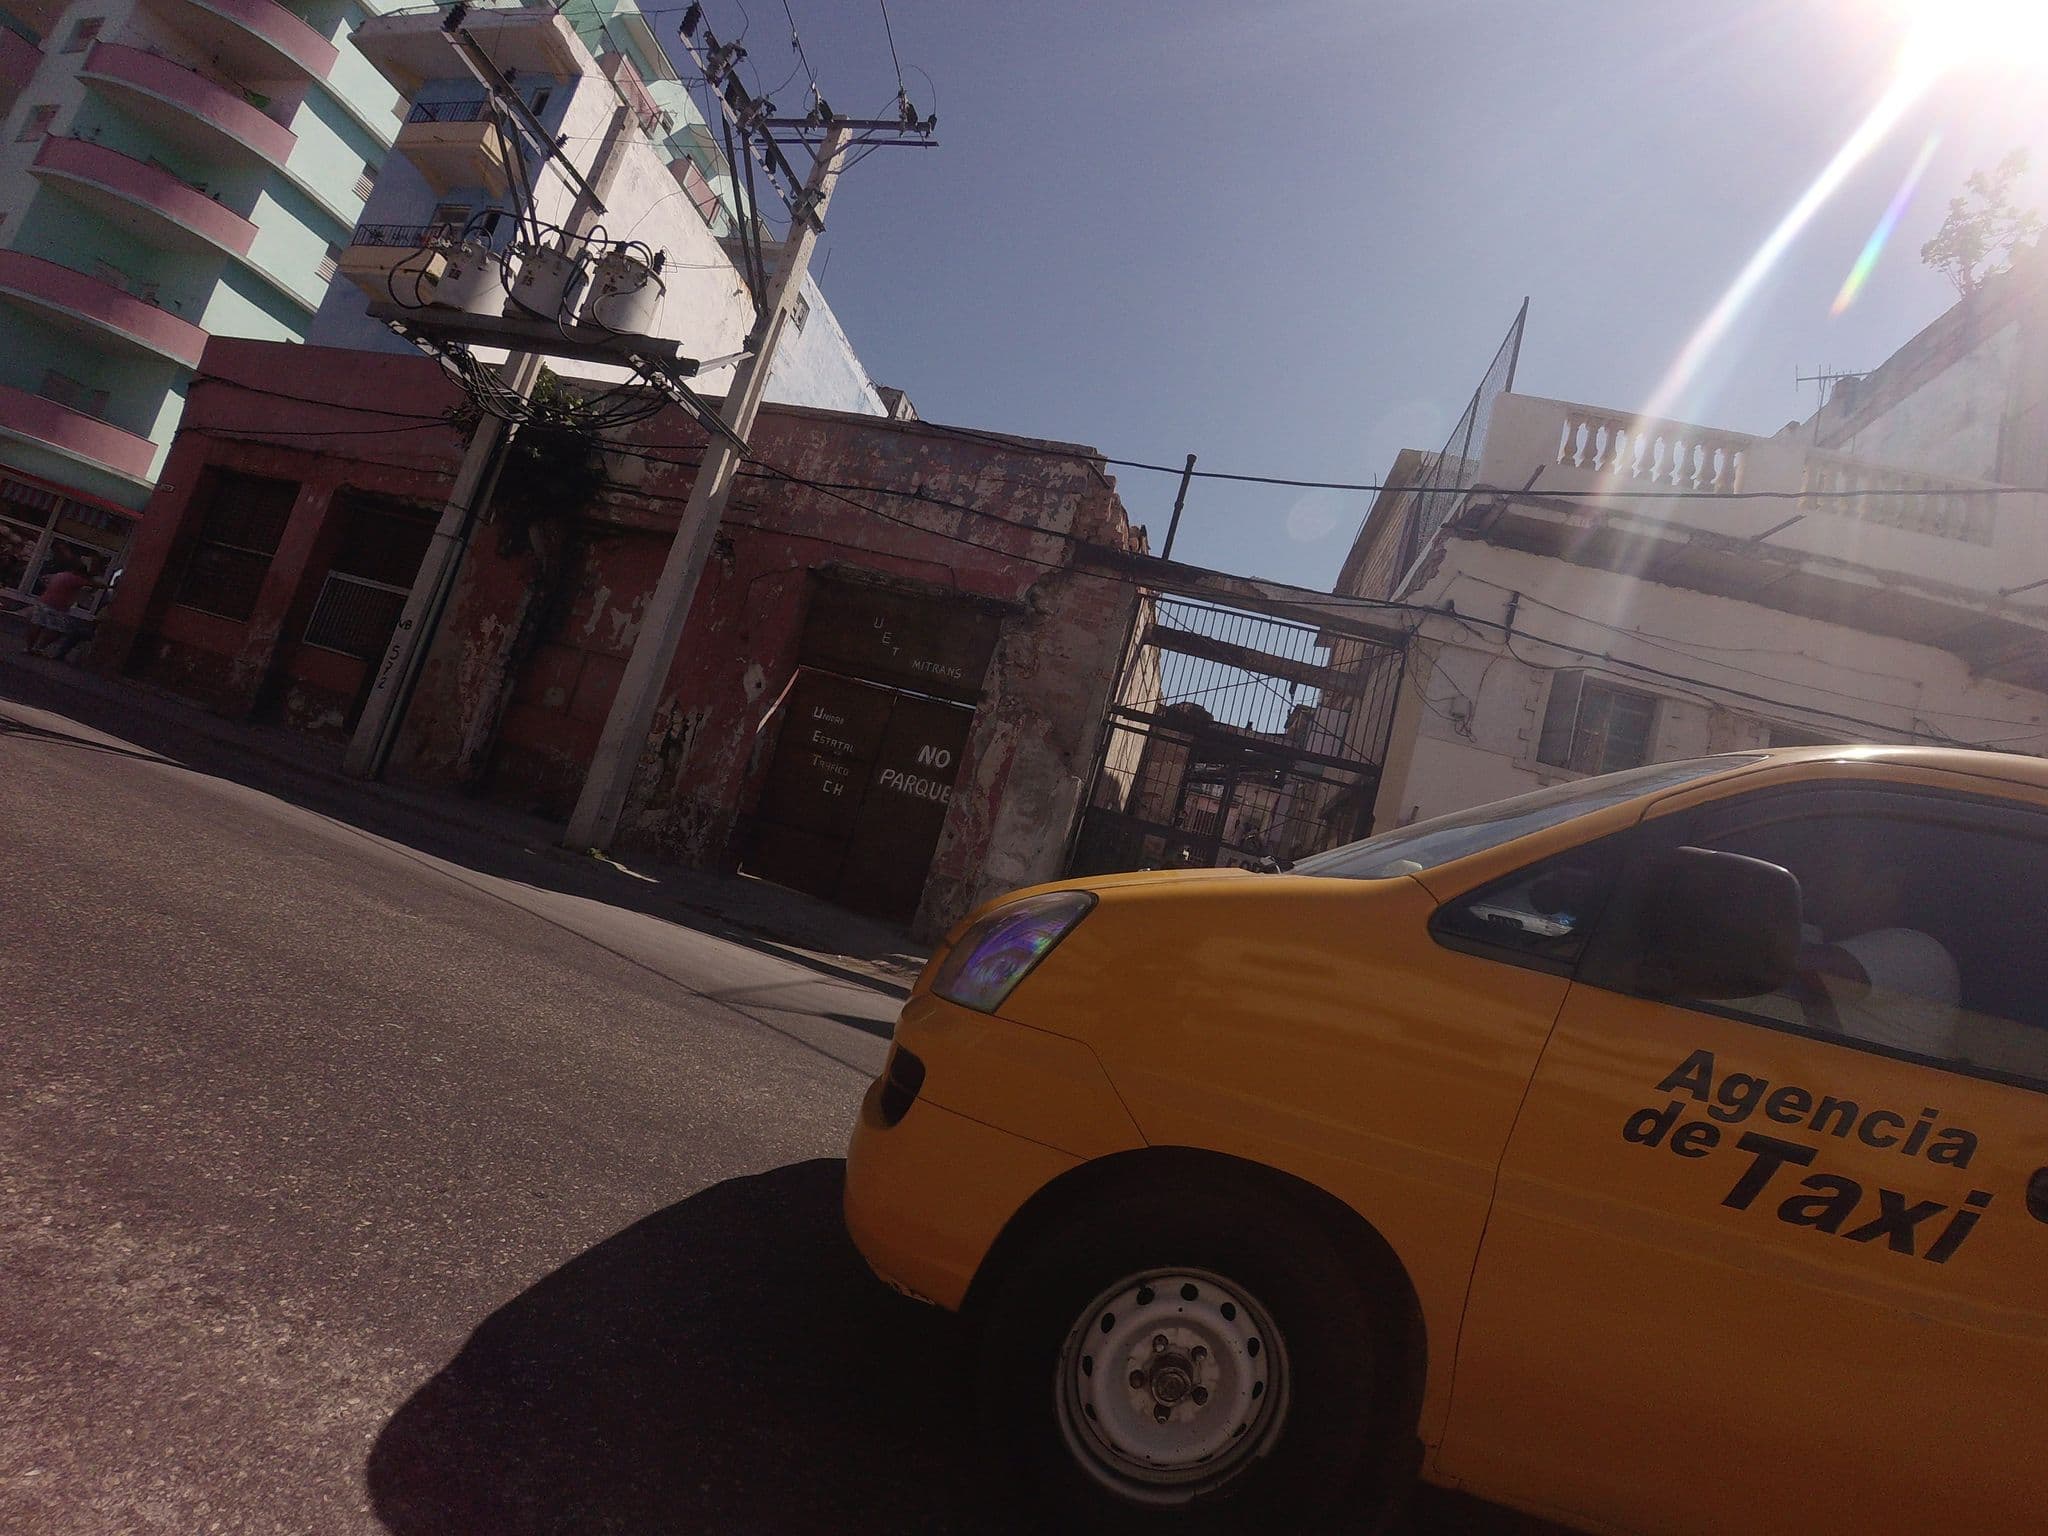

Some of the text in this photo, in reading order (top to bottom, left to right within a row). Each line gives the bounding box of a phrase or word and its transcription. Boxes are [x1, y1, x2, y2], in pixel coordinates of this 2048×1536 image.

[911, 660, 962, 680] MITRANS
[917, 744, 951, 768] NO
[880, 768, 952, 803] PARQUE
[1654, 1049, 1978, 1169] Agencia
[1622, 1101, 1721, 1158] de
[1721, 1130, 1995, 1264] Taxi
